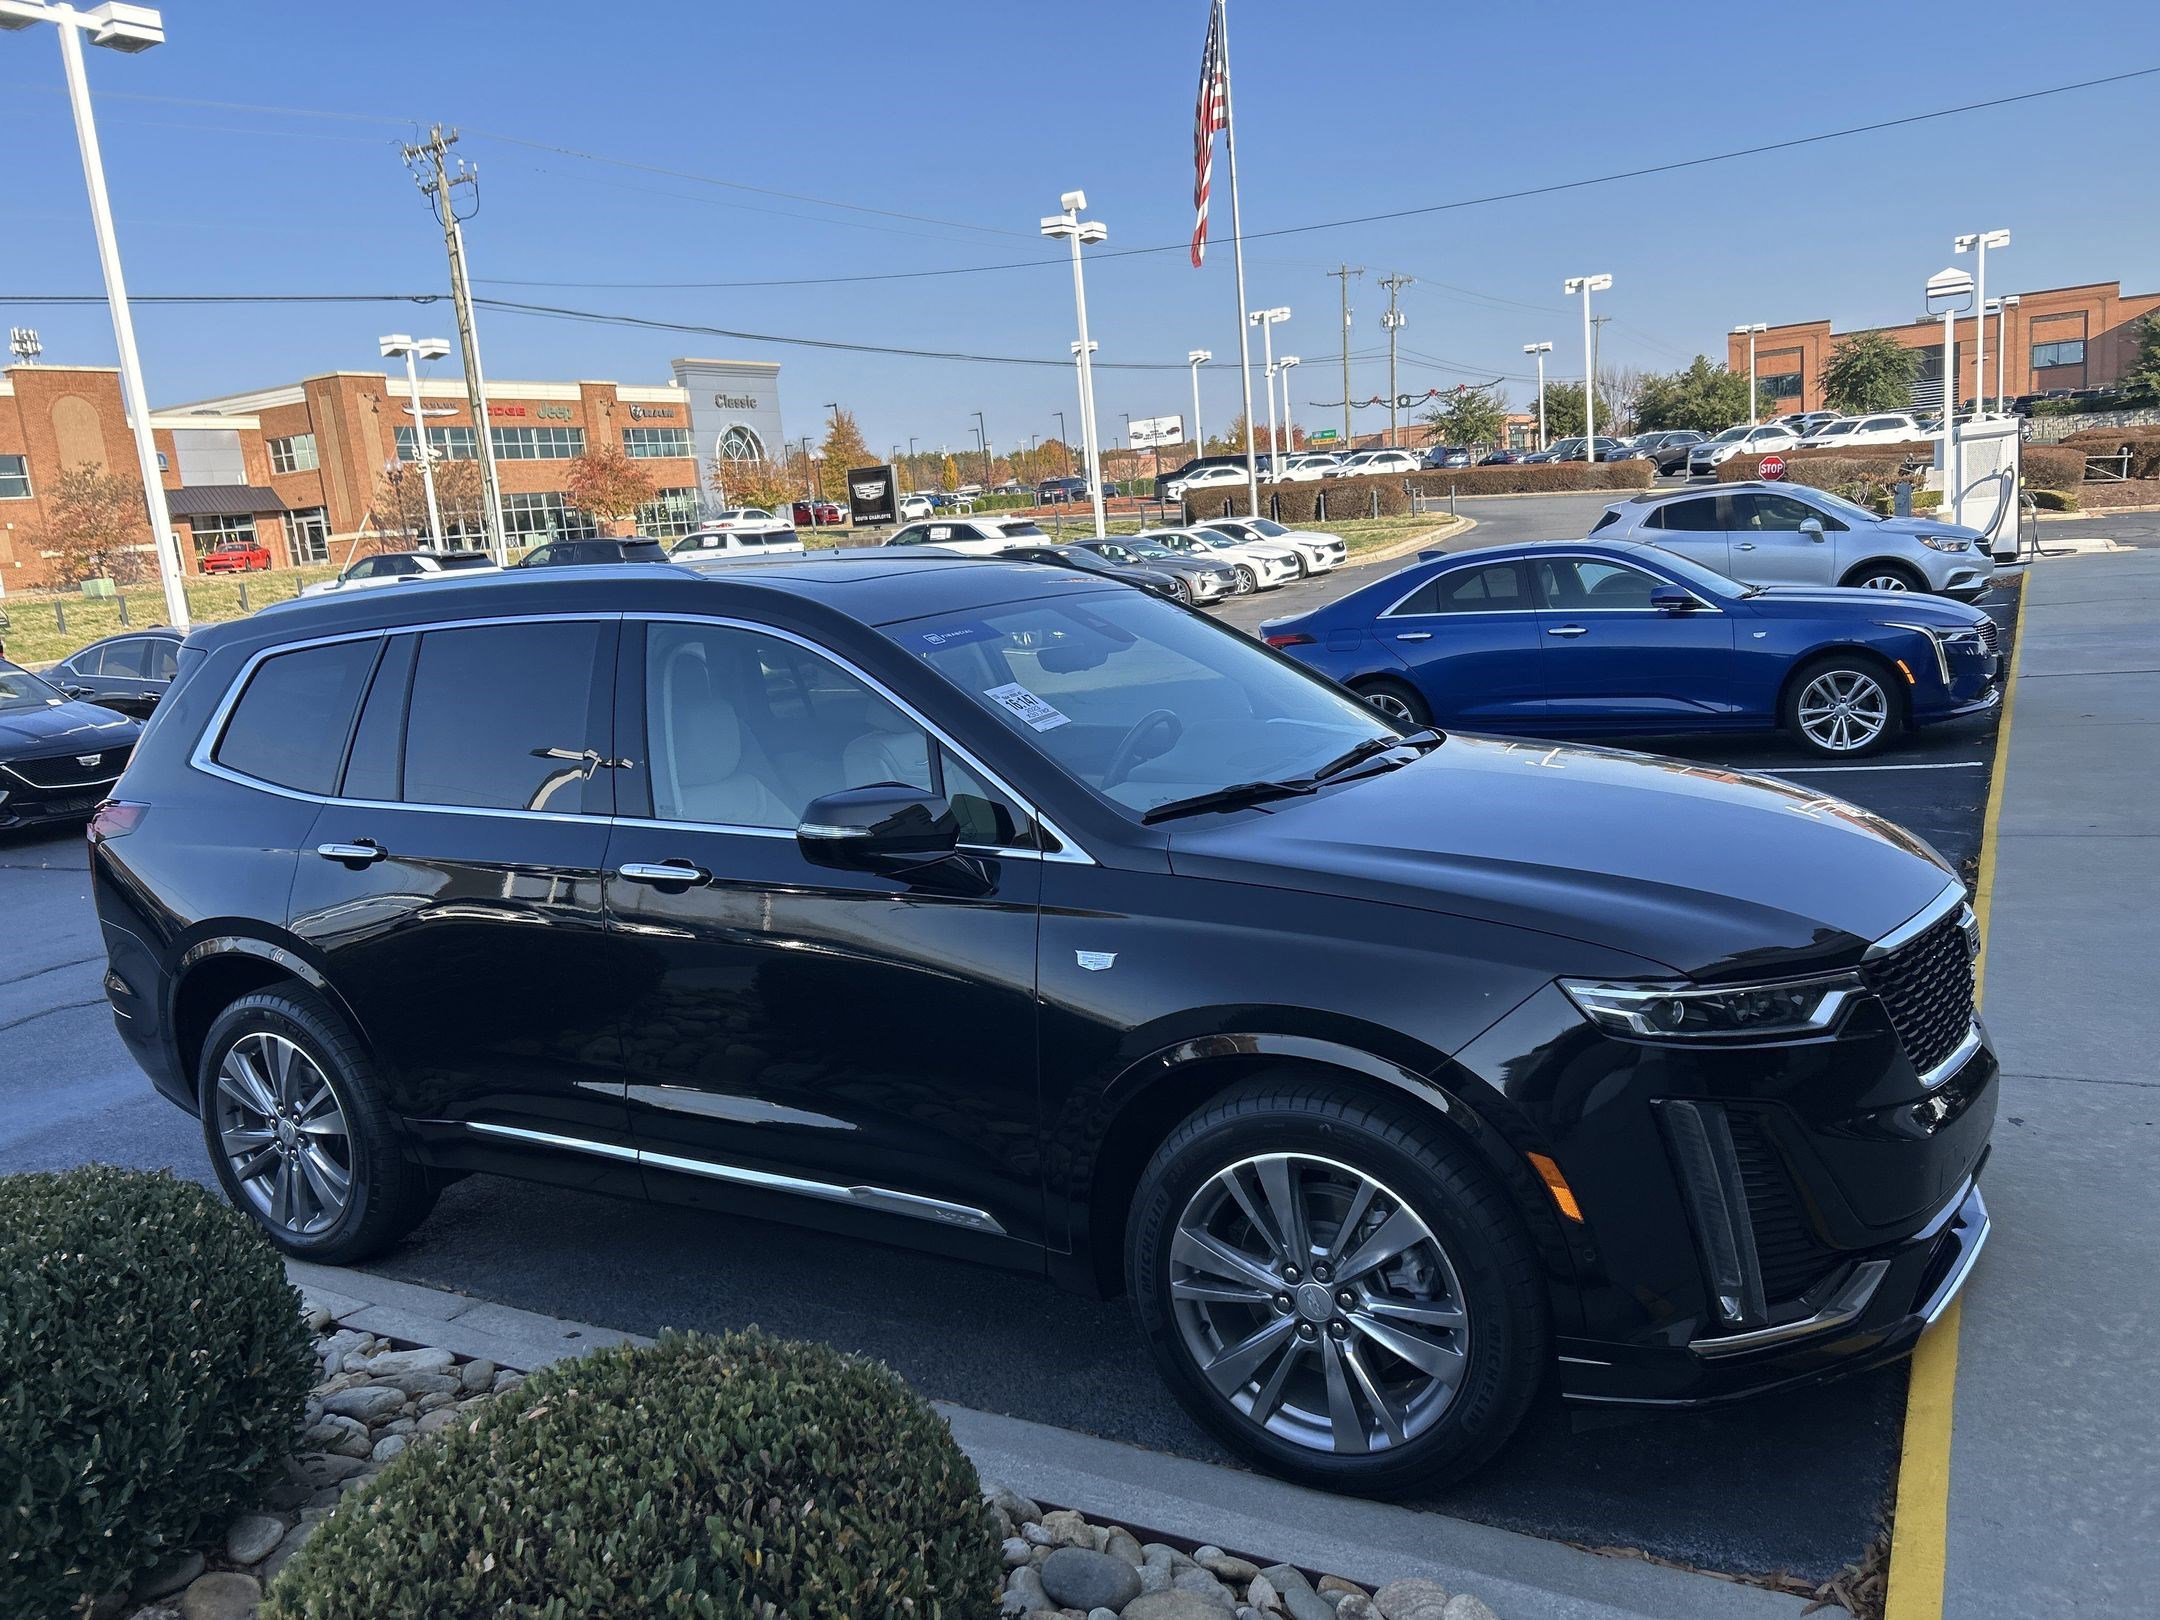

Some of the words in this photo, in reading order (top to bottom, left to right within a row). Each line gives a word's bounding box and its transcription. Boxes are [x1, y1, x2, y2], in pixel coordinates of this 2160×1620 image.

[714, 393, 758, 410] Classic
[537, 400, 572, 422] Jeep
[642, 408, 675, 418] RAM
[1760, 463, 1784, 474] STOP
[1141, 1192, 1169, 1295] MICHELIN
